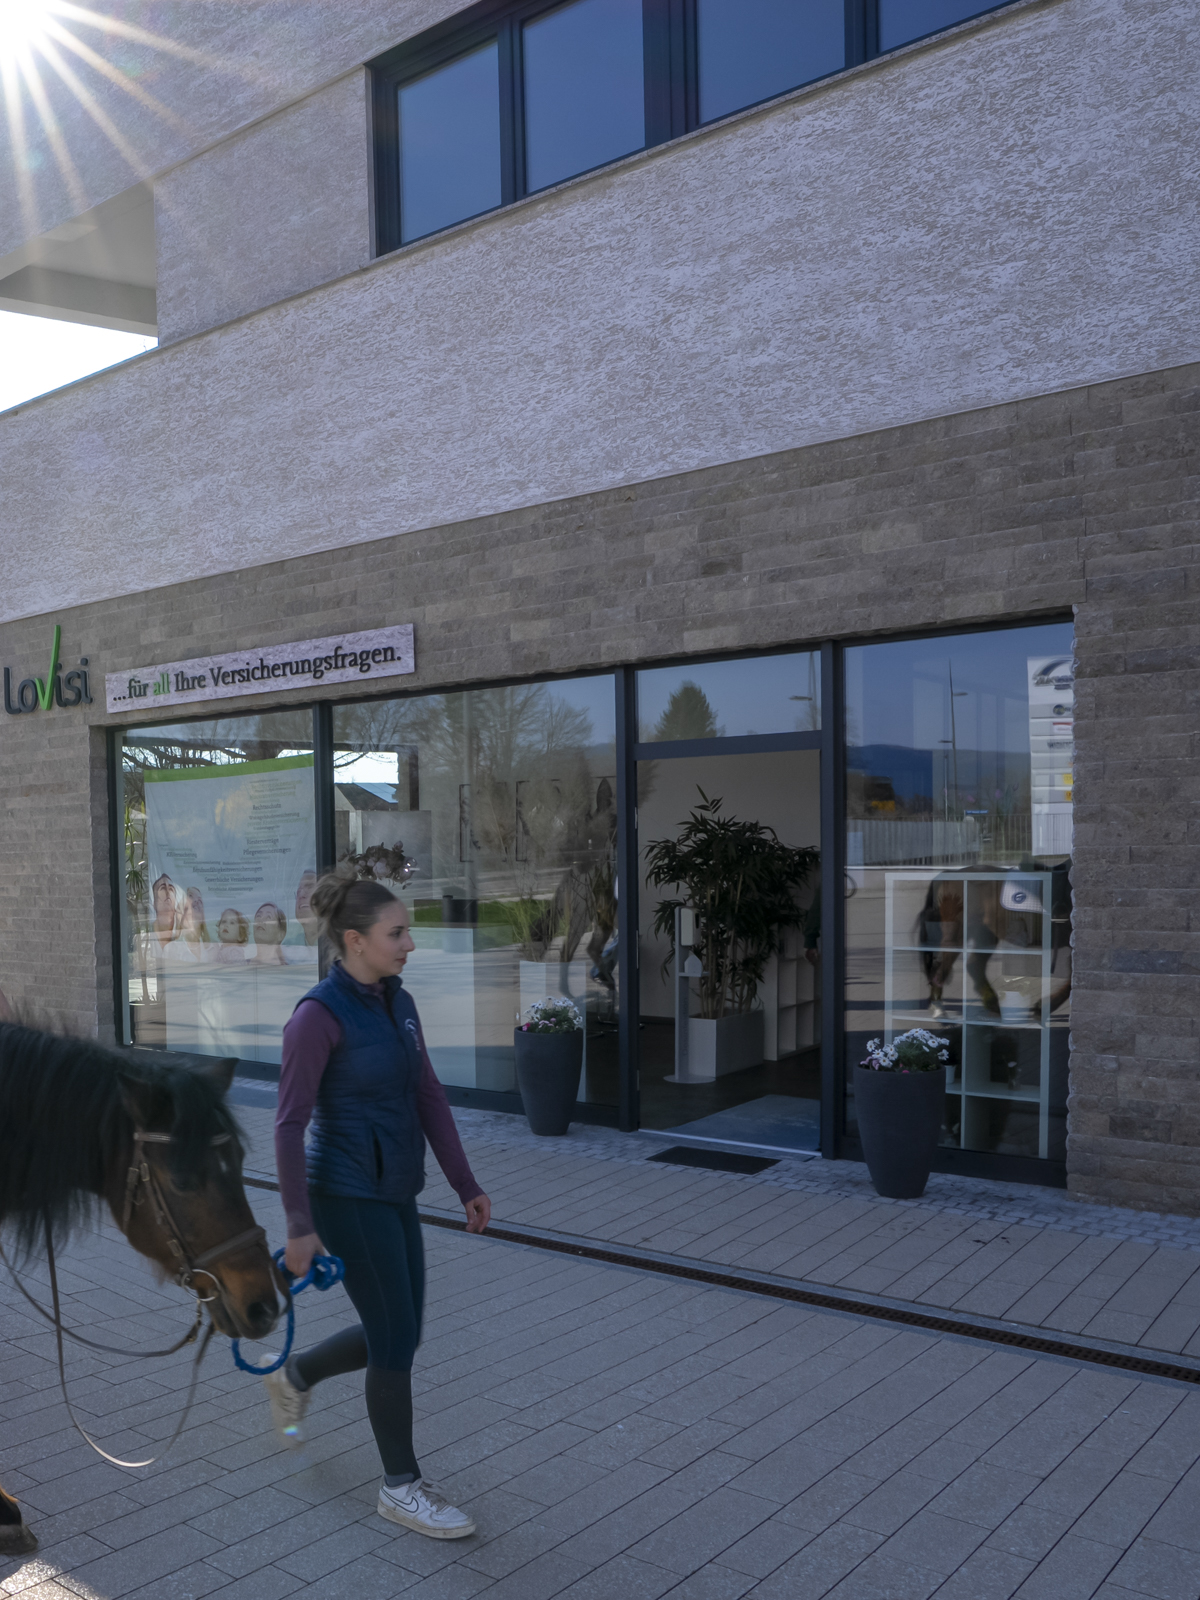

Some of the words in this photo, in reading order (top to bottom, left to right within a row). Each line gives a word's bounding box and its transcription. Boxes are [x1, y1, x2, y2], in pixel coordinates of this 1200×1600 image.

[153, 672, 170, 695] all
[174, 671, 206, 692] Ihre
[209, 645, 402, 687] Versicherungsfragen.
